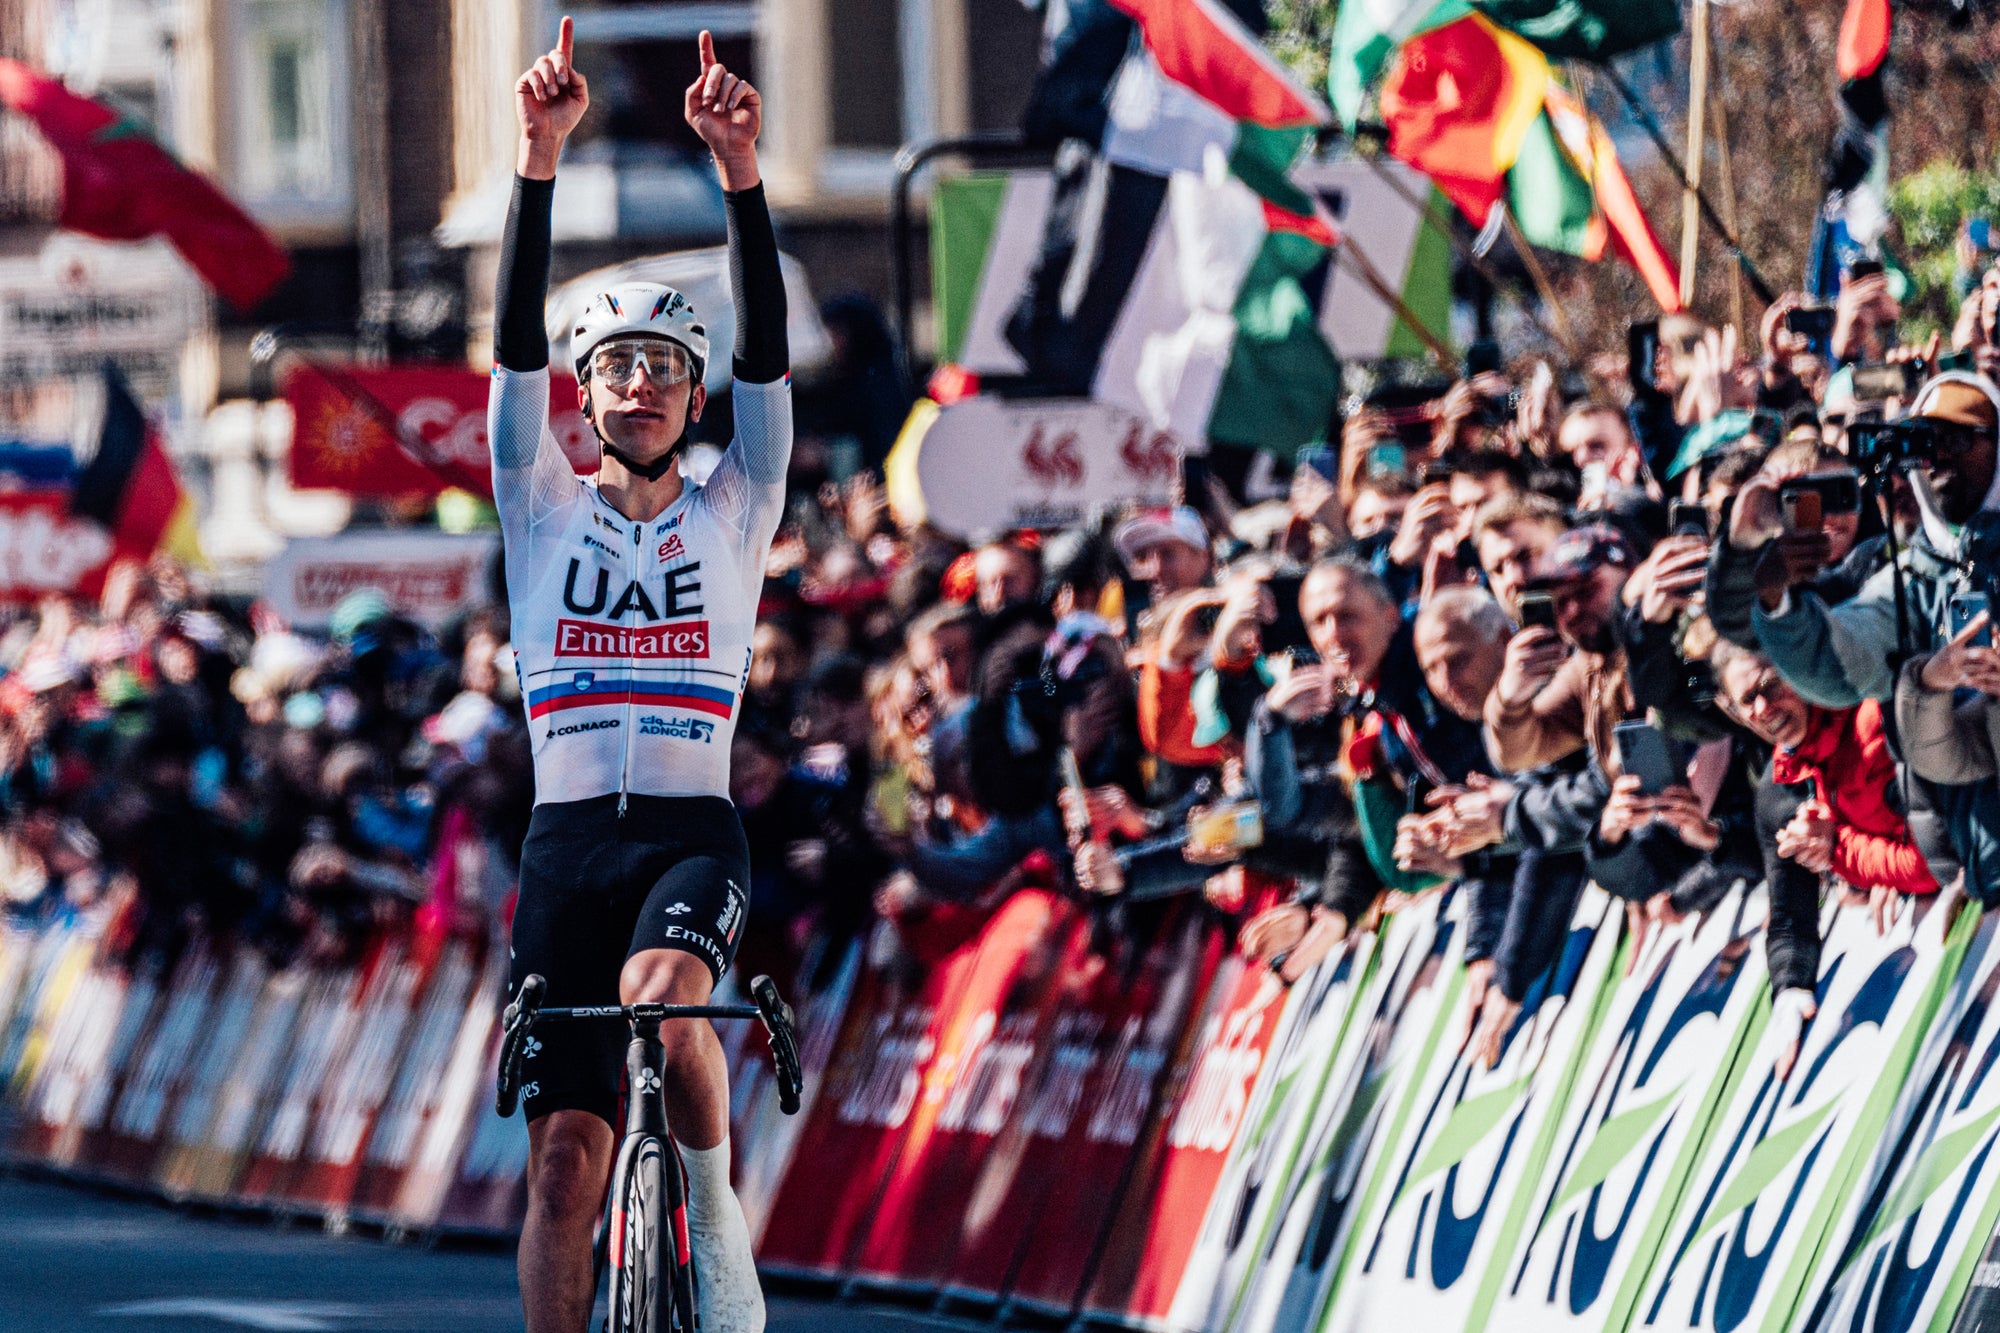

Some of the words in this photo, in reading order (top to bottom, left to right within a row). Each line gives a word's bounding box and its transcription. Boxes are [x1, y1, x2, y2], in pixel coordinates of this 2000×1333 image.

[563, 558, 704, 621] UAE
[559, 624, 705, 655] Emirates
[557, 719, 620, 736] COLNAGO
[639, 725, 688, 739] ADNOC
